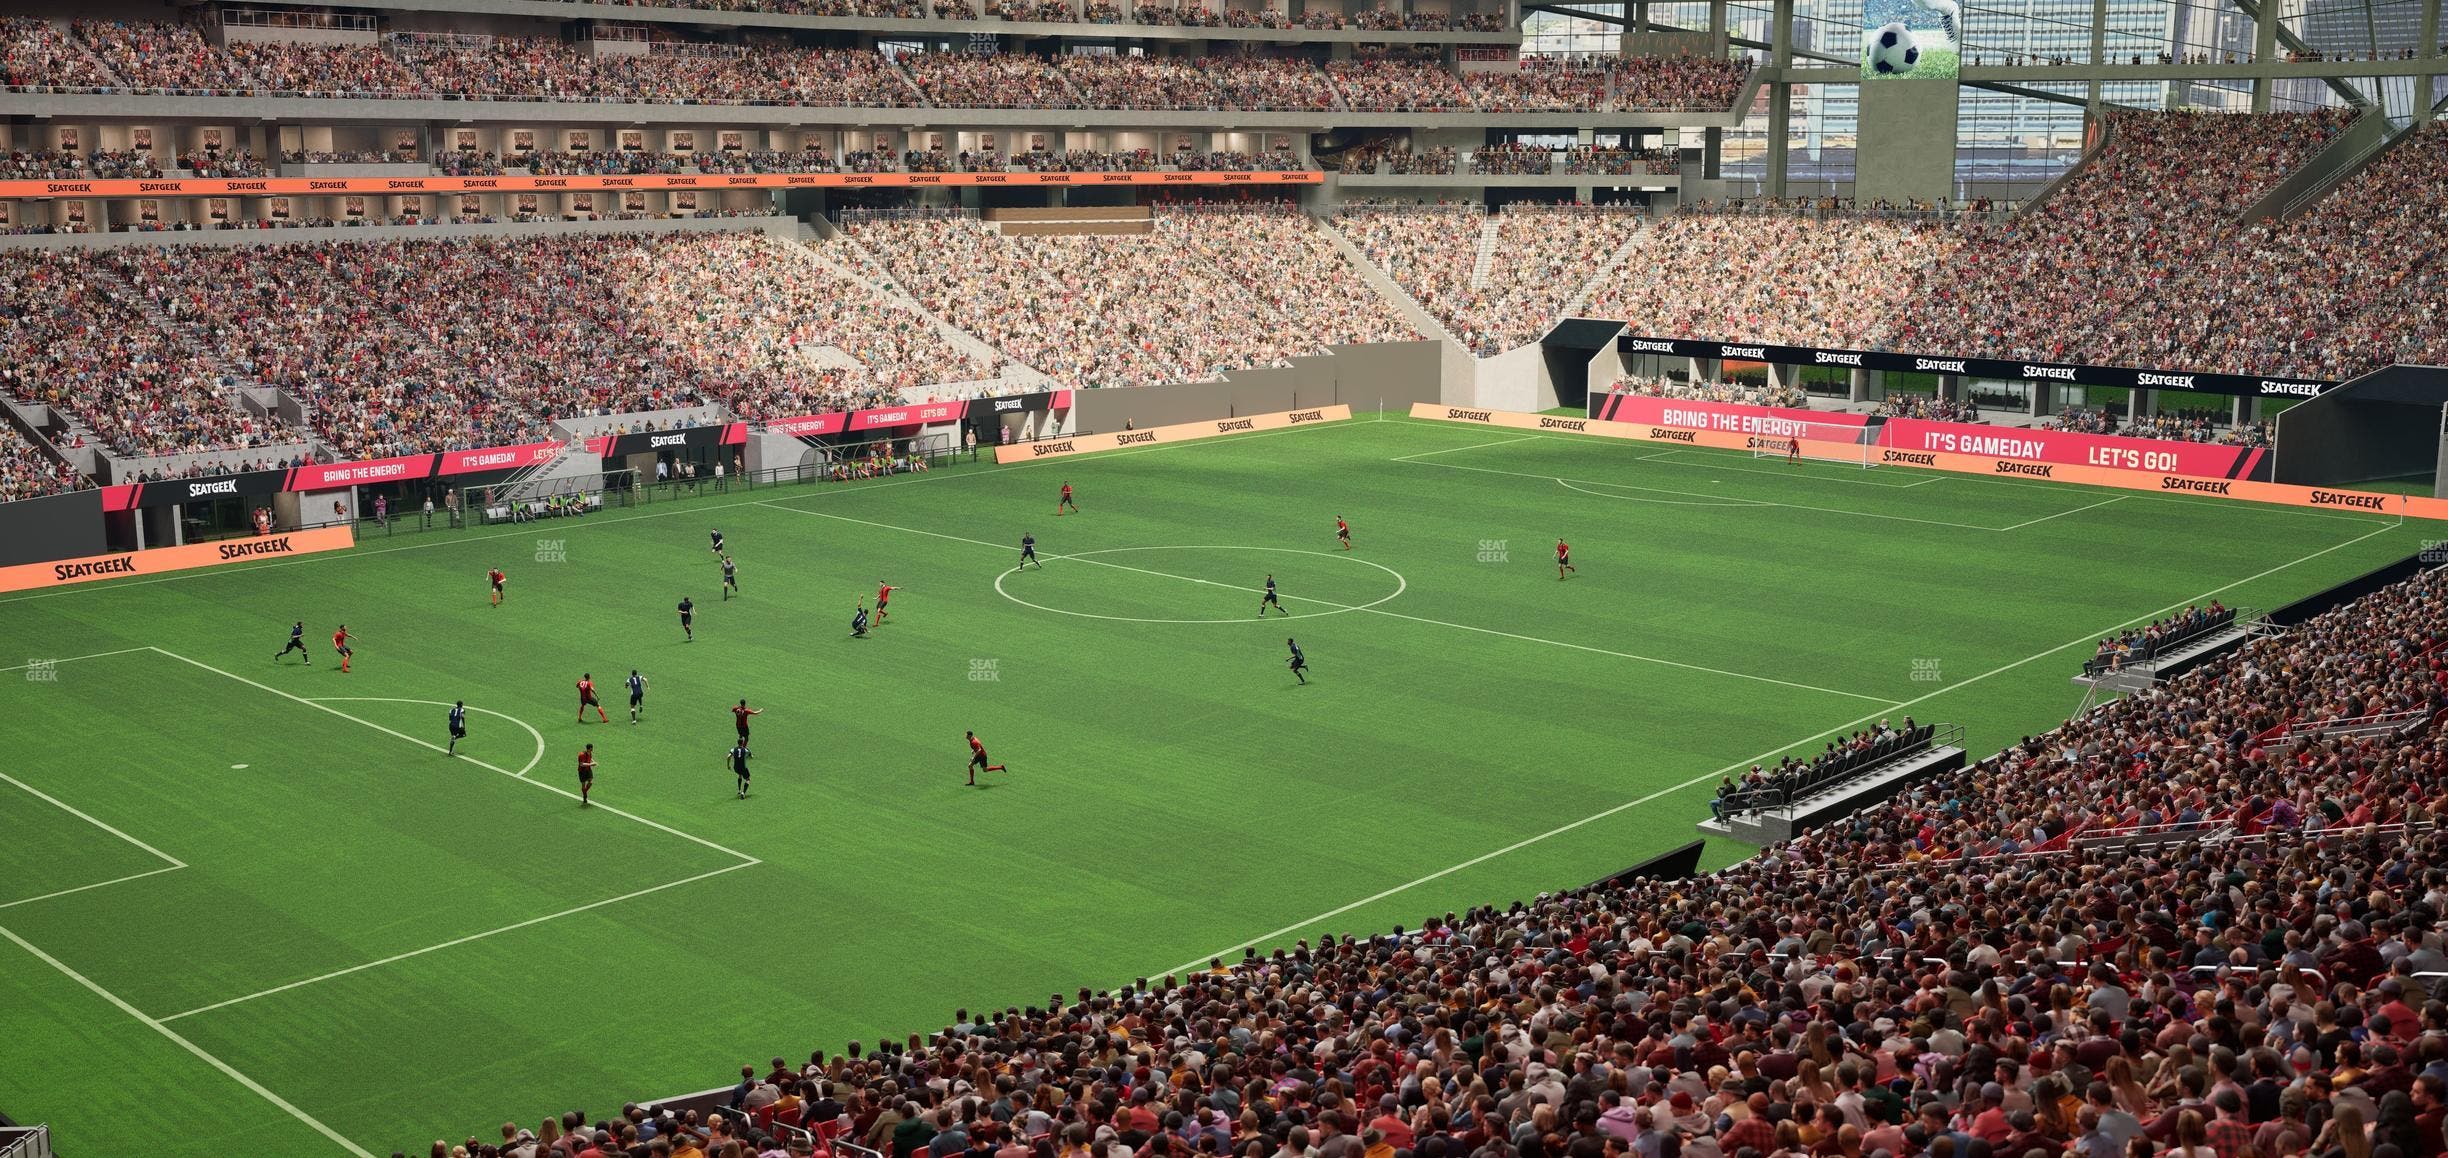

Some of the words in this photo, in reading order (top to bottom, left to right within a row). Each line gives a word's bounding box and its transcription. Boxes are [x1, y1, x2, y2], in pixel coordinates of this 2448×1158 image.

[48, 184, 91, 192] SEATGEEK
[140, 183, 181, 191] SEATGEEK
[227, 182, 266, 190] SEATGEEK
[310, 181, 347, 189] SEATGEEK
[389, 180, 424, 188] SEATGEEK
[464, 180, 497, 188] SEATGEEK
[535, 179, 567, 187] SEATGEEK
[1633, 340, 1674, 353] SEATGEEK
[1722, 346, 1764, 359] SEATGEEK
[1816, 351, 1862, 365] SEATGEEK
[1916, 359, 1965, 372] SEATGEEK
[2024, 366, 2075, 380] SEATGEEK
[2138, 373, 2194, 388] SEATGEEK
[2261, 381, 2321, 396] SEATGEEK
[995, 399, 1022, 411] SEATGEEK
[880, 412, 907, 423] GAMEDAY
[1289, 410, 1323, 423] SEATGEEK
[1448, 409, 1491, 422] SEATGEEK
[1218, 419, 1253, 432] SEATGEEK
[1540, 418, 1586, 431] SEATGEEK
[1664, 409, 1707, 427] BRING
[1712, 413, 1738, 431] THE
[1743, 416, 1806, 437] ENERGY!
[651, 433, 686, 447] SEATGEEK
[1117, 431, 1156, 445] SEATGEEK
[1650, 428, 1696, 442] SEATGEEK
[1033, 441, 1075, 456] SEATGEEK
[1925, 432, 1955, 450] IT'S
[1961, 436, 2044, 458] GAMEDAY
[463, 457, 477, 466] IT'S
[479, 453, 515, 465] GAMEDAY
[1883, 449, 1936, 466] SEATGEEK
[2089, 447, 2139, 467] LET'S
[2145, 452, 2177, 471] GO!
[324, 470, 350, 481] BRING
[352, 468, 368, 478] THE
[370, 464, 404, 476] ENERGY!
[1996, 461, 2053, 478] SEATGEEK
[189, 478, 237, 497] SEATGEEK
[2162, 477, 2230, 494] SEATGEEK
[2310, 491, 2384, 509] SEATGEEK
[219, 538, 292, 559] SEATGEEK
[55, 557, 135, 580] SEATGEEK
